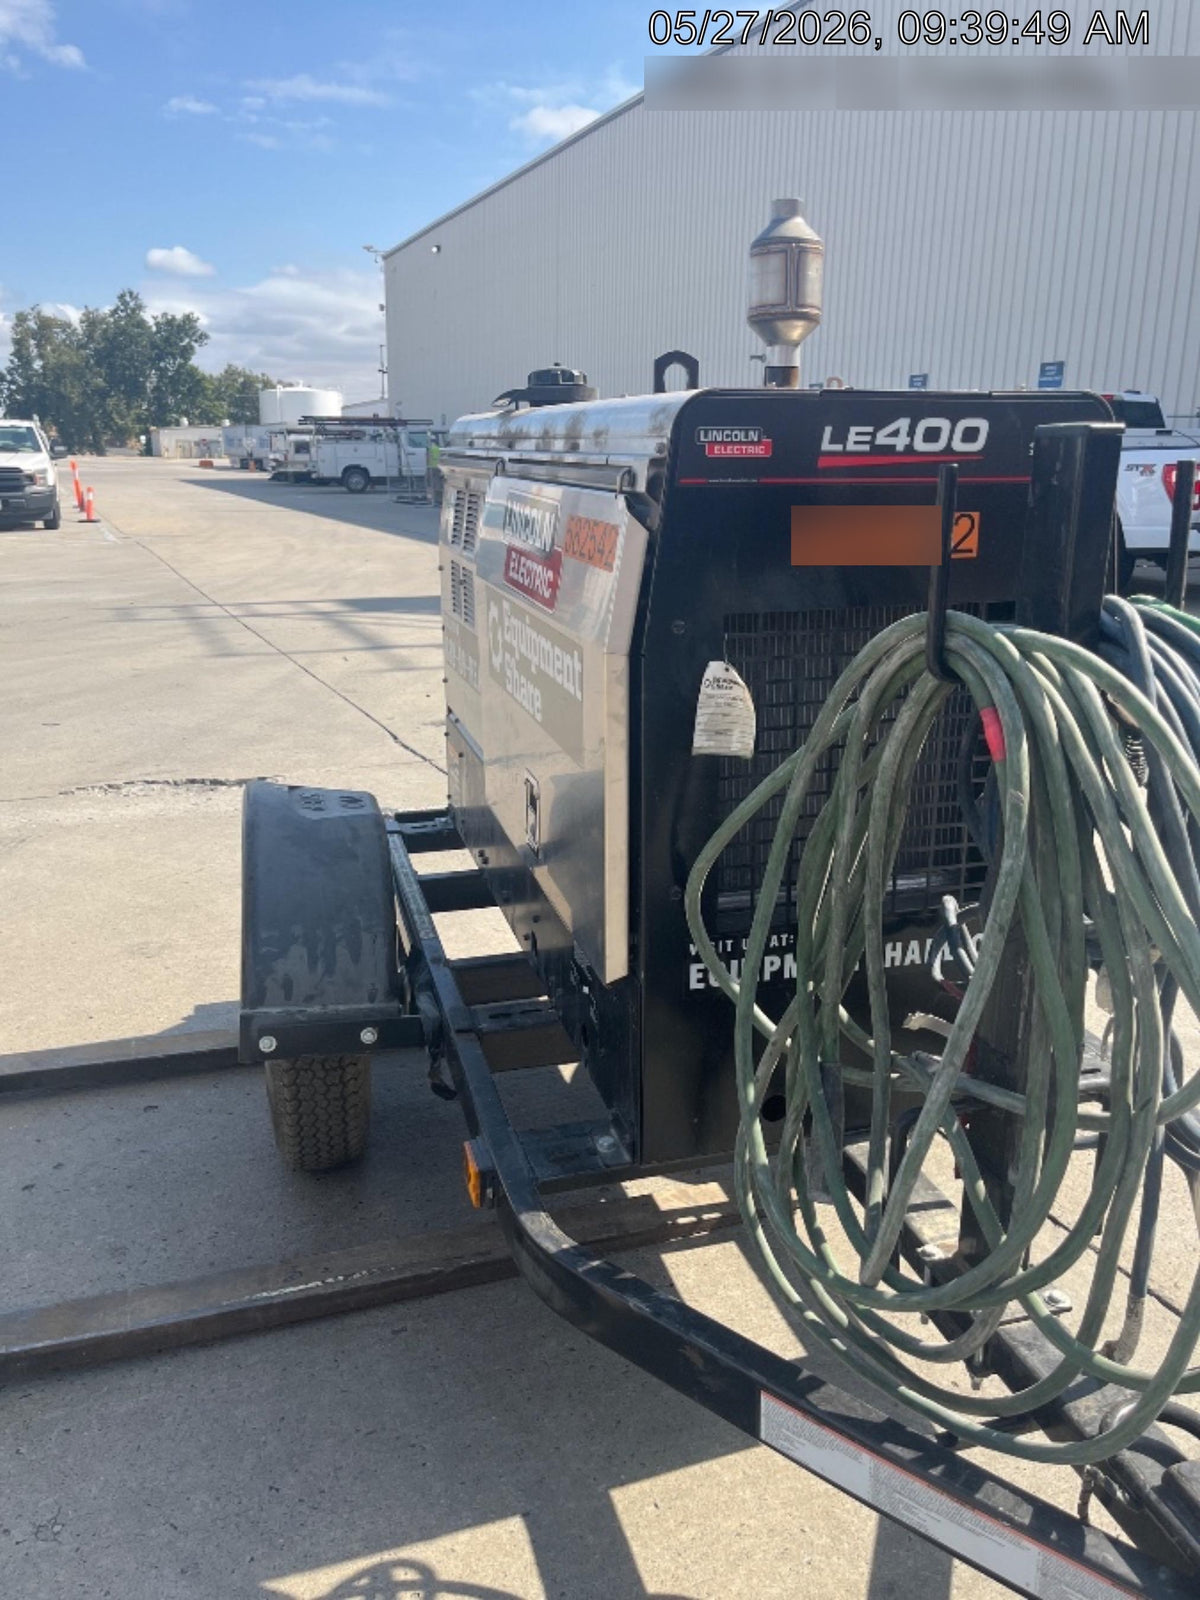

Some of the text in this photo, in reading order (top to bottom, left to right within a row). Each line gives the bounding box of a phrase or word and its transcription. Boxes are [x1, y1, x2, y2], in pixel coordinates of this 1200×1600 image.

[700, 429, 759, 442] LINCOLN
[714, 445, 766, 455] ELECTRIC
[820, 417, 990, 452] LE400
[503, 500, 557, 552] LINCOLN
[509, 553, 554, 599] ELECTRIC
[503, 600, 583, 701] Equipment
[503, 652, 543, 723] Share
[689, 940, 733, 956] VIT
[769, 932, 794, 948] AT:
